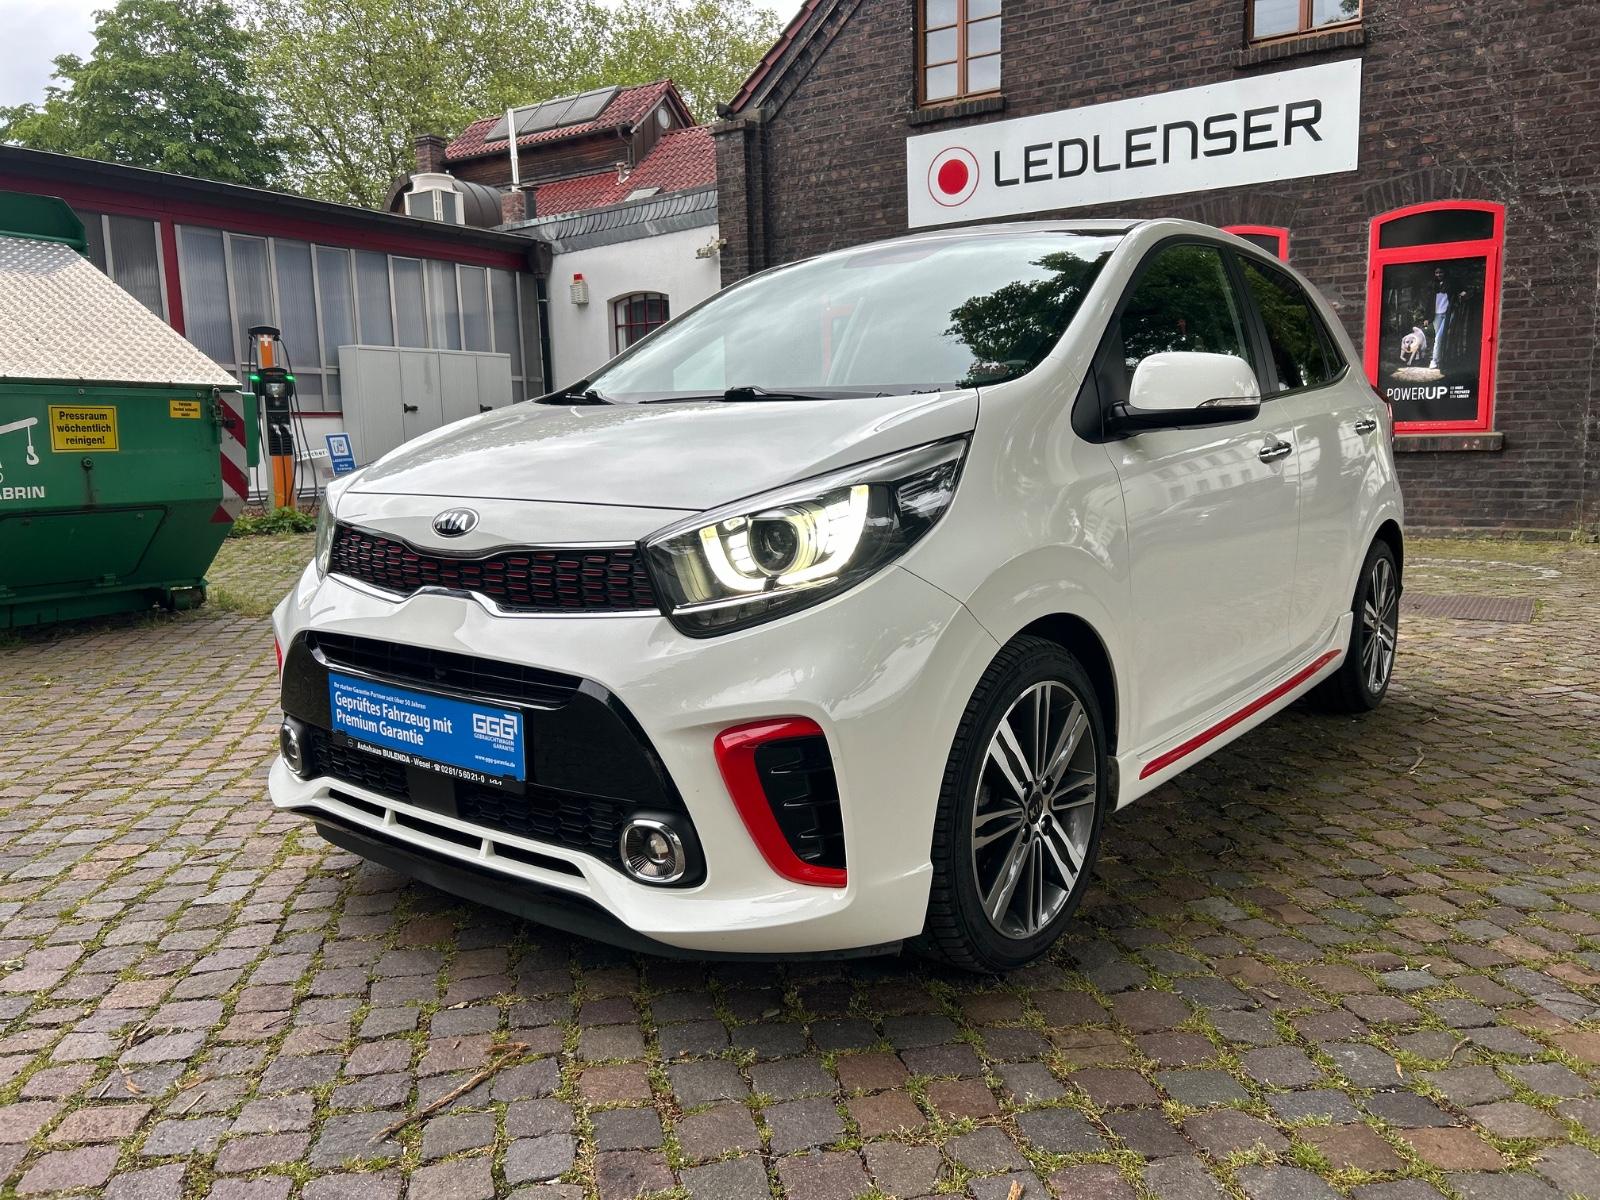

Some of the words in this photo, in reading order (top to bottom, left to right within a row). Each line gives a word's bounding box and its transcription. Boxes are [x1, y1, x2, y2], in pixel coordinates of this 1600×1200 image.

[994, 98, 1323, 187] LEDLENSER
[59, 411, 108, 420] Pressraum
[56, 423, 112, 432] wöchentlich
[65, 436, 105, 446] reinigen!
[0, 486, 46, 500] BRIN
[335, 691, 381, 717] Geprüftes
[382, 703, 431, 733] Fahrzeug
[433, 717, 453, 734] mit
[336, 708, 378, 733] Premium
[379, 720, 424, 746] Garantie
[357, 742, 382, 756] Autohaus
[382, 749, 411, 764] BULENDA
[413, 757, 431, 769] Wesel
